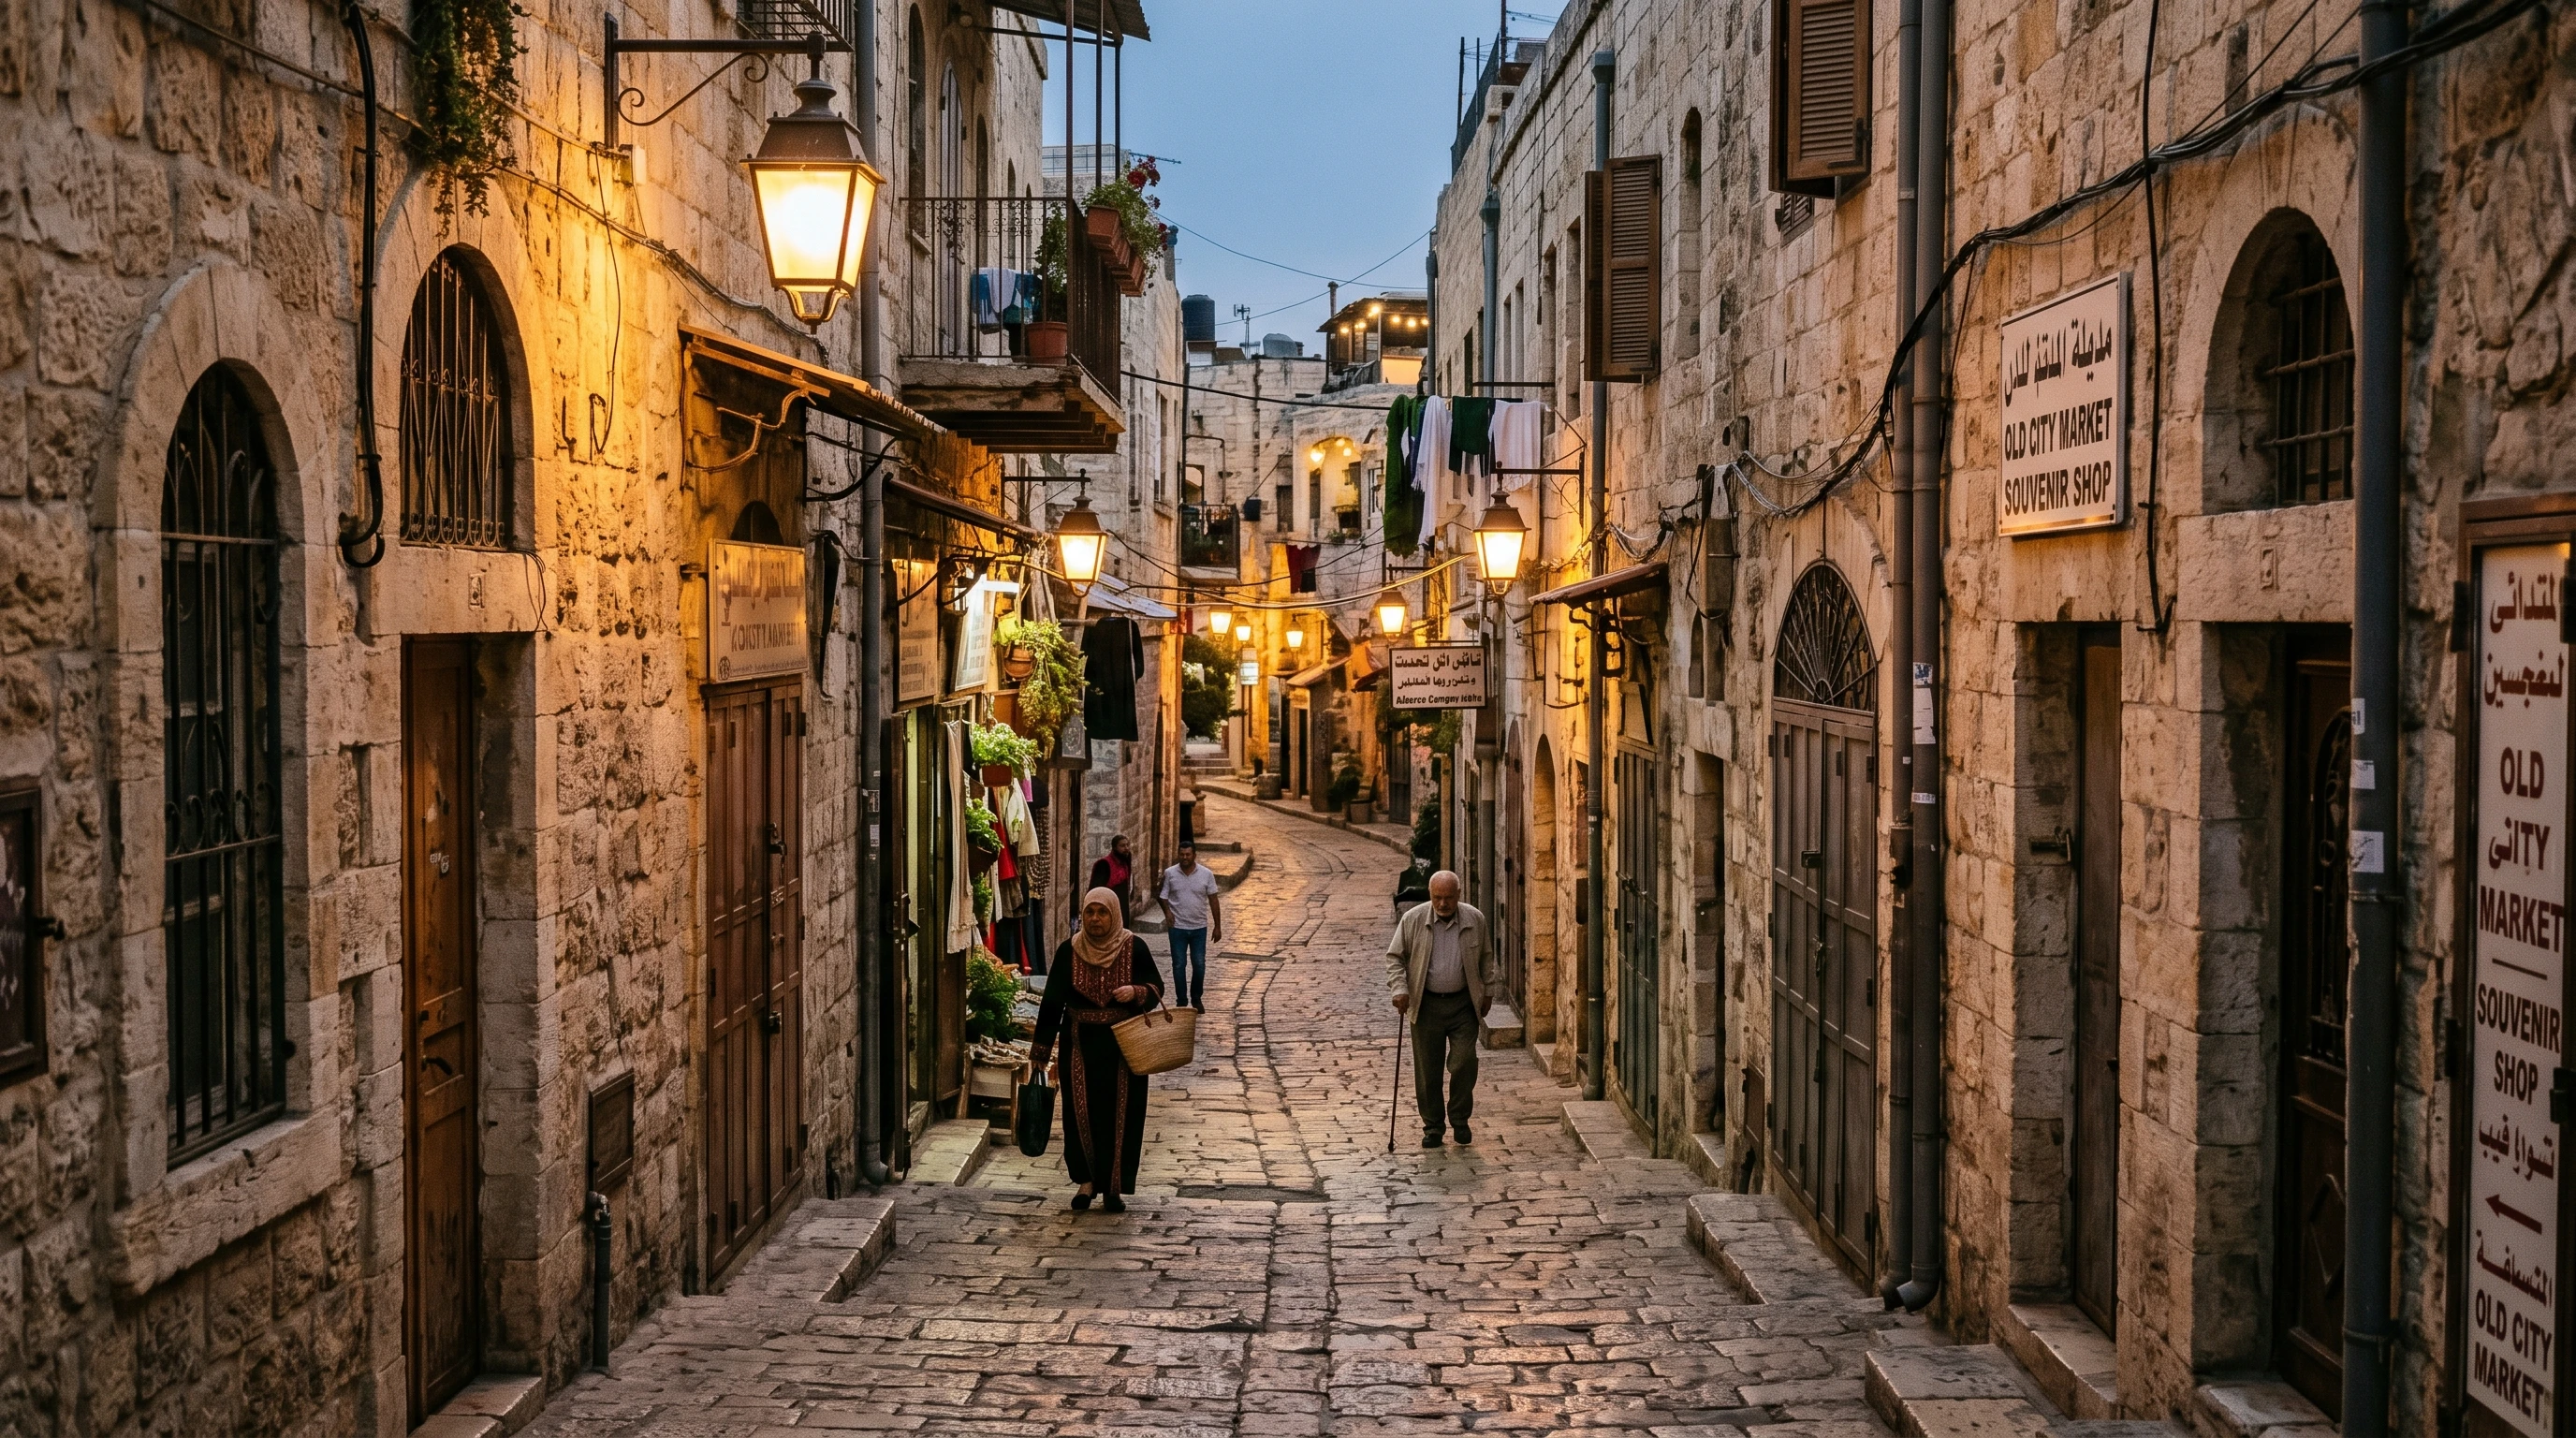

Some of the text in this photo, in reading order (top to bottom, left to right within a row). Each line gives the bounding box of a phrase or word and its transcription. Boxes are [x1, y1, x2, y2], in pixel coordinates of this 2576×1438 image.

[2004, 397, 2113, 462] OLD CITY MARKET
[2004, 460, 2112, 517] SOUVENIR SHOP
[2500, 746, 2544, 799] OLD
[2480, 885, 2564, 953] MARKET
[2477, 982, 2561, 1054] SOUVENIR
[2494, 1049, 2539, 1106] SHOP
[2475, 1288, 2552, 1371] OLD CITY
[2474, 1342, 2544, 1423] MARKET
